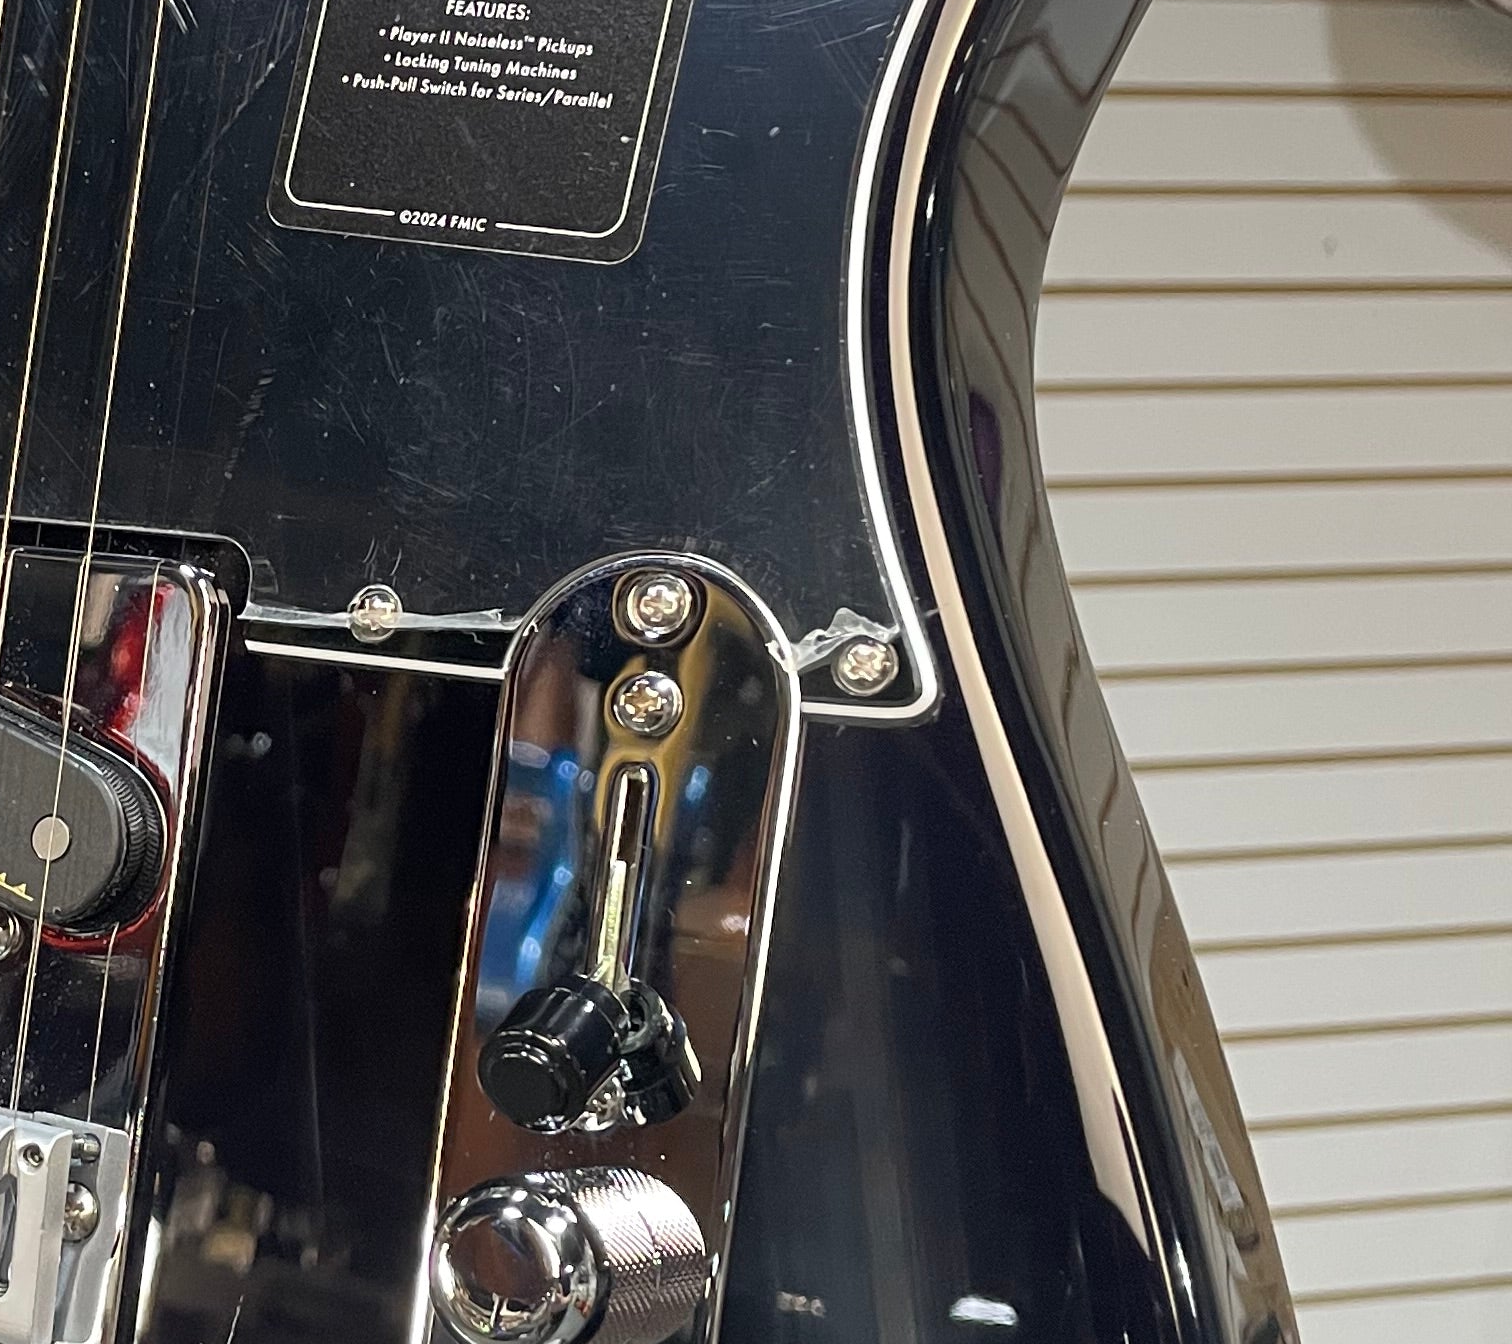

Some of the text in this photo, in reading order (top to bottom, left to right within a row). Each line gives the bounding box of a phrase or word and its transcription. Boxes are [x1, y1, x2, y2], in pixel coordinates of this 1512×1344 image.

[445, 0, 531, 21] FEATURES:
[390, 26, 437, 45] Player
[439, 30, 451, 45] II
[537, 37, 594, 58] Pickups
[395, 52, 577, 80] Locking Tuning Machines
[353, 73, 613, 109] Push-Pull Switch for Series/Parallel
[399, 209, 488, 232] ©2024 FMIC
